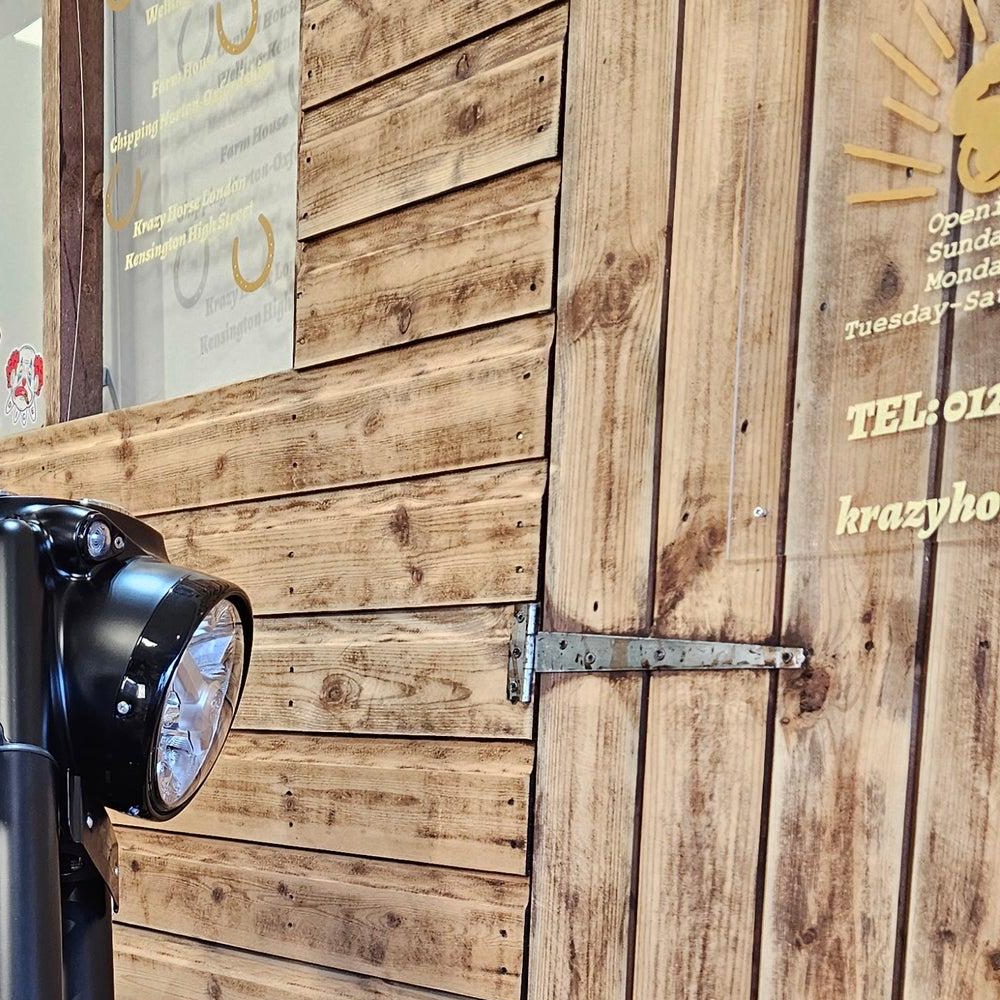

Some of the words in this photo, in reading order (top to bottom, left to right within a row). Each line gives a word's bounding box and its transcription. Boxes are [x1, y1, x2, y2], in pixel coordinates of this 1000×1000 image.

[110, 119, 160, 153] Chipping
[133, 212, 166, 238] Krazy
[168, 196, 201, 223] Horse
[202, 177, 247, 208] London
[124, 232, 186, 271] Kensington
[836, 480, 1000, 540] krazyho
